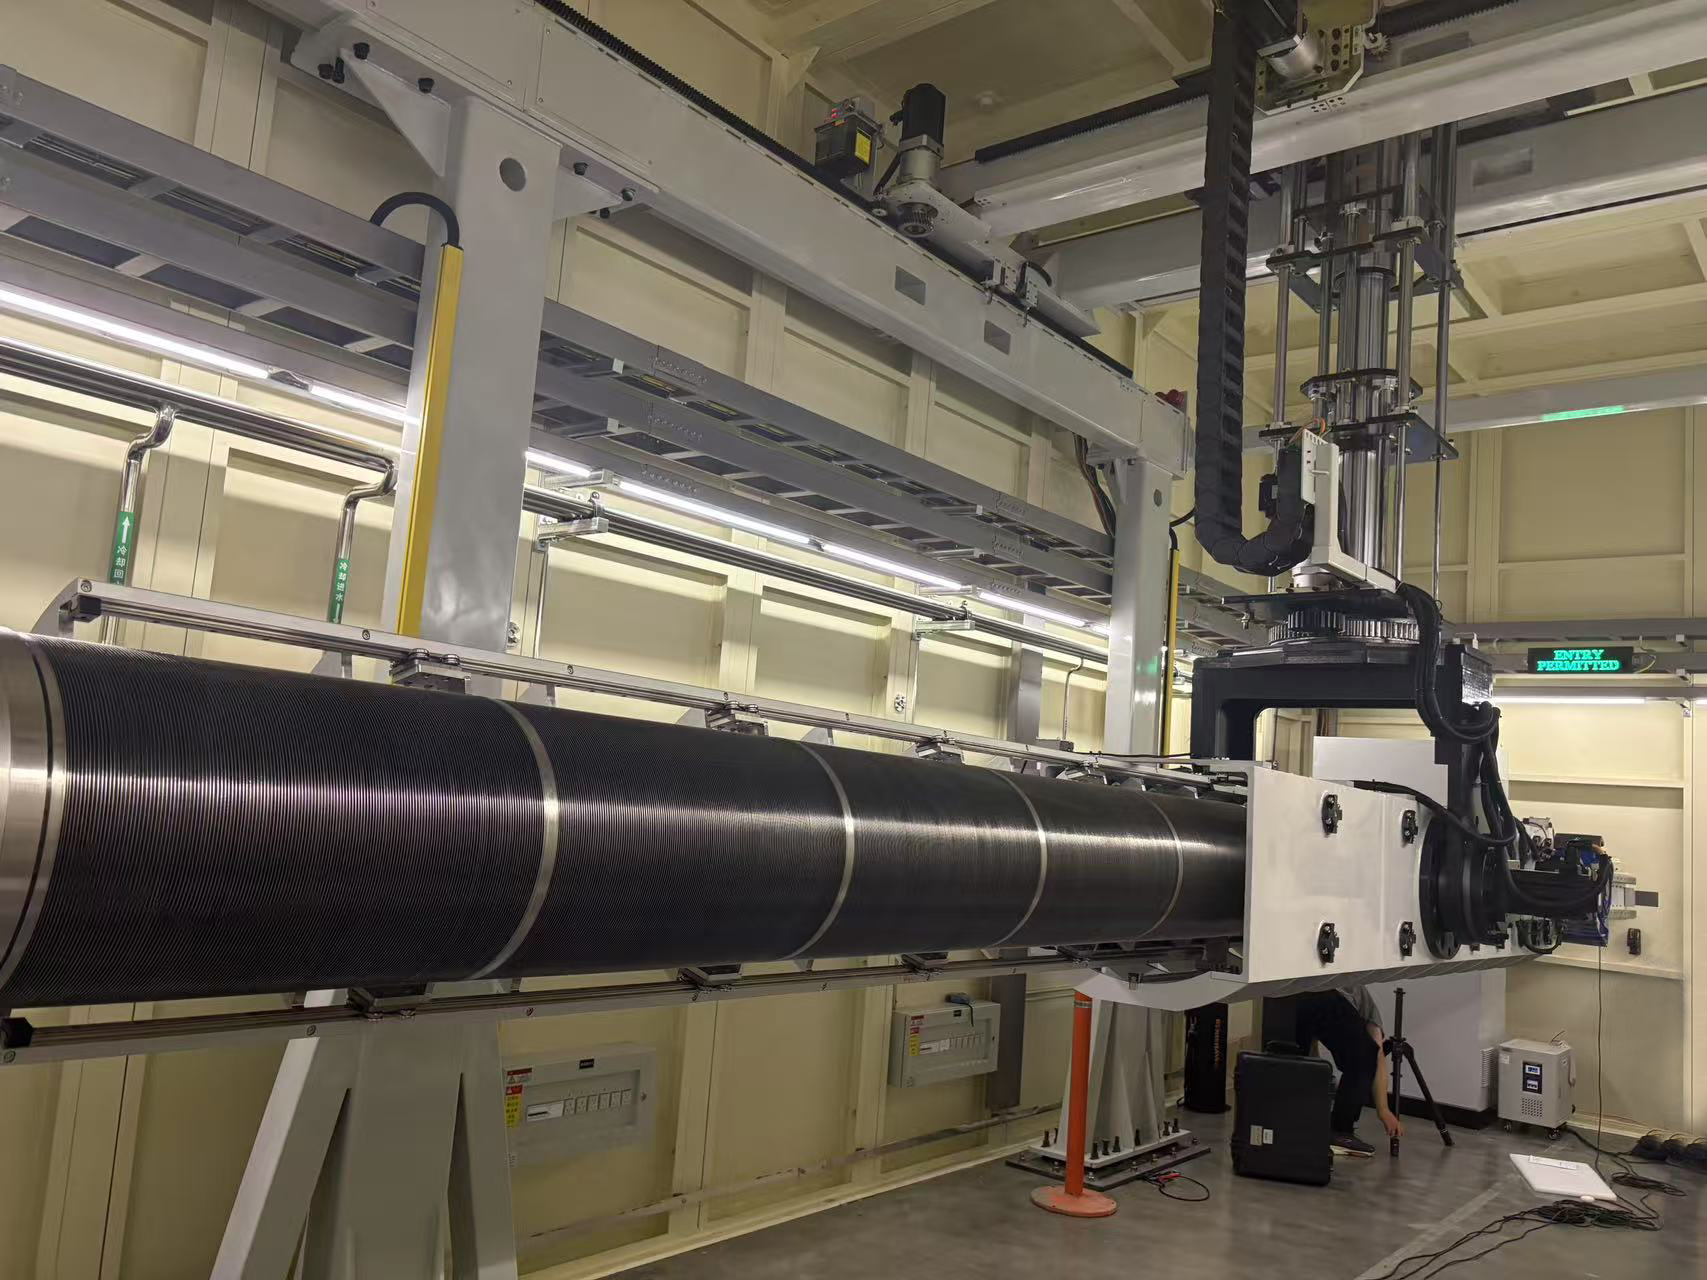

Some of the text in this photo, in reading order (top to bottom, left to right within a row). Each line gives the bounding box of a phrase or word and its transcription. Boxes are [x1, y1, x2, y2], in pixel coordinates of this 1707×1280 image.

[113, 545, 127, 584] 冷却回
[335, 561, 348, 601] 冷却进水
[1537, 660, 1620, 671] PERMITTED
[1553, 649, 1605, 660] ENTRY
